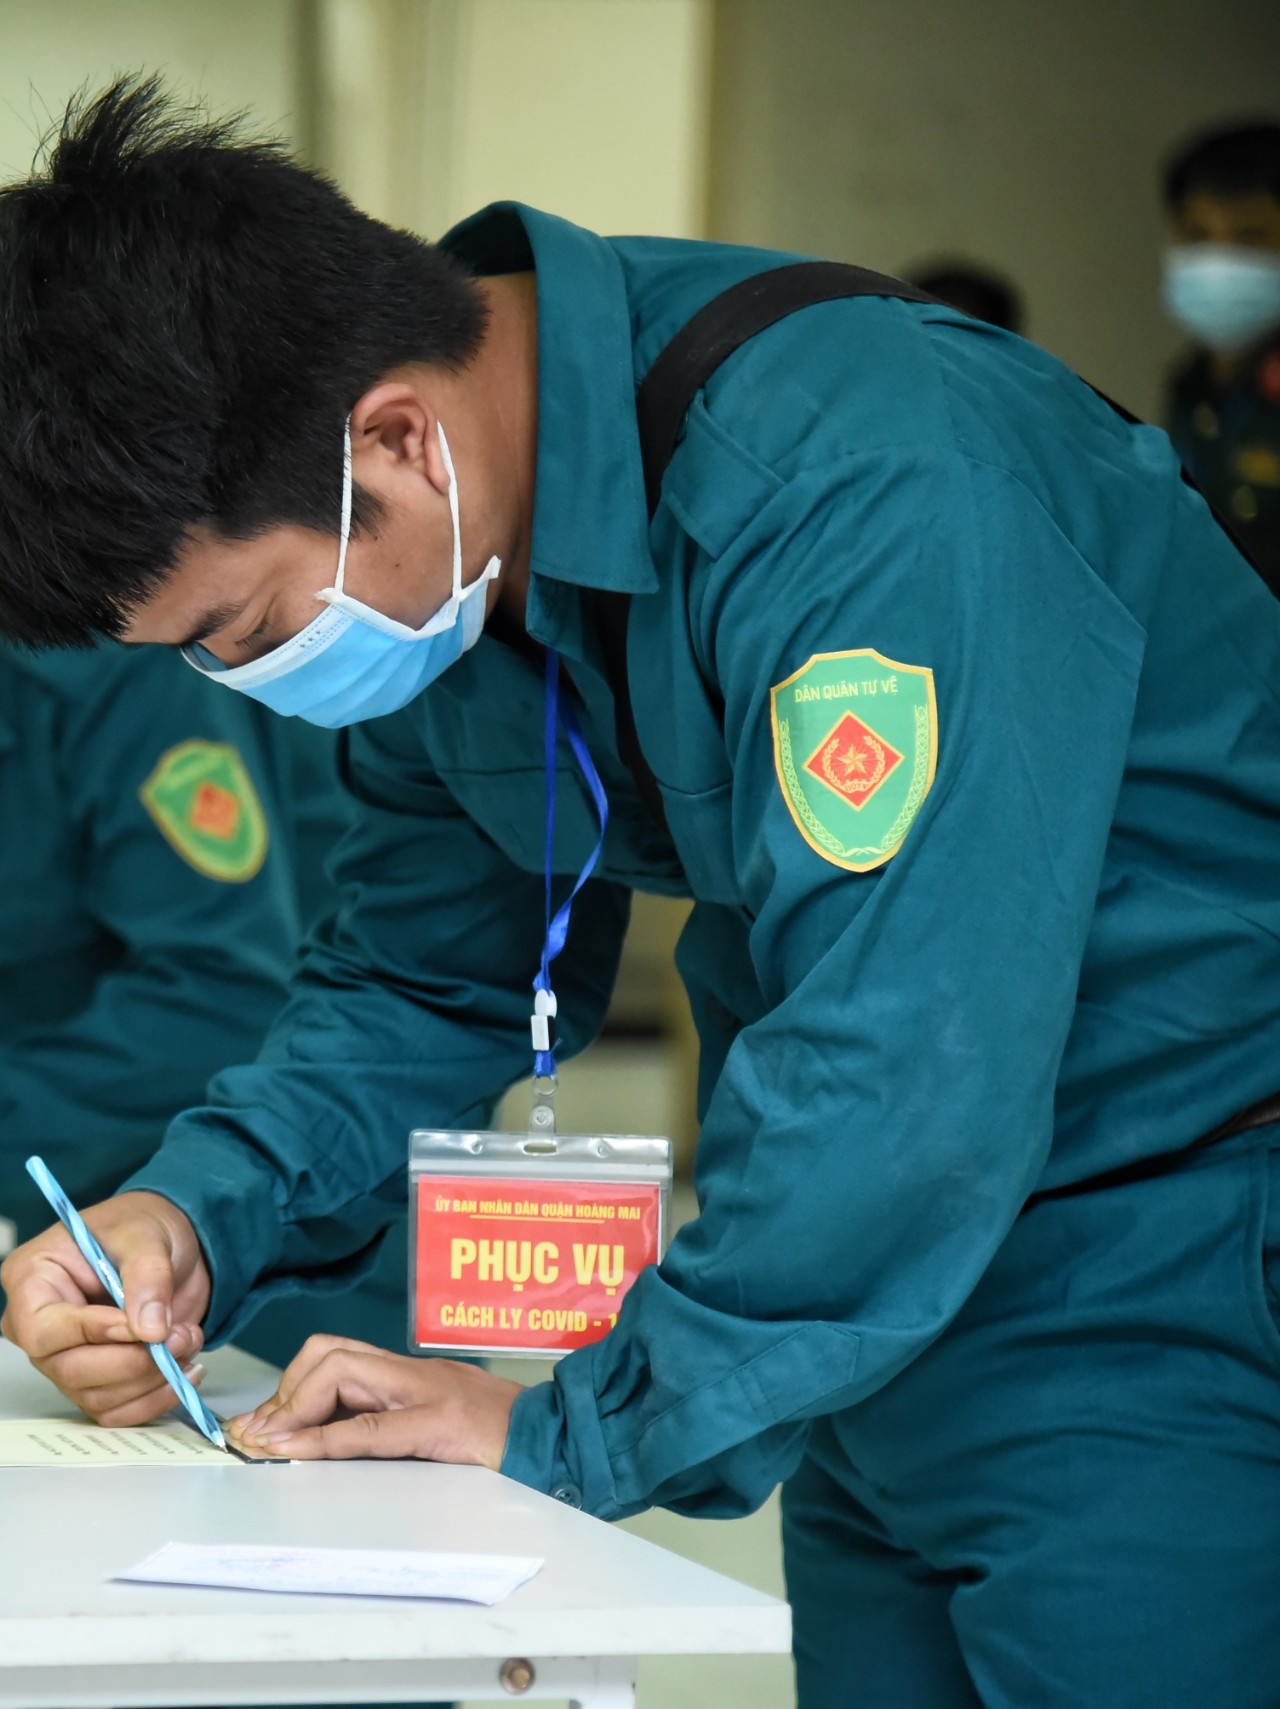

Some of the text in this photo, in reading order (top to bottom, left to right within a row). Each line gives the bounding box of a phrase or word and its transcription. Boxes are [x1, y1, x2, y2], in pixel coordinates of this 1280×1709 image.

[795, 675, 899, 703] DÂN QUÂN TỰ VỆ
[452, 1199, 478, 1214] BAN
[479, 1199, 512, 1216] NHÂN
[515, 1200, 539, 1217] DÂN
[541, 1201, 574, 1219] QUẬN
[618, 1206, 641, 1220] MAI
[450, 1238, 625, 1296] PHỤC VỤ
[440, 1301, 495, 1329] CÁCH
[499, 1307, 523, 1329] LY
[528, 1308, 588, 1332] COVID
[608, 1312, 618, 1329] 1
